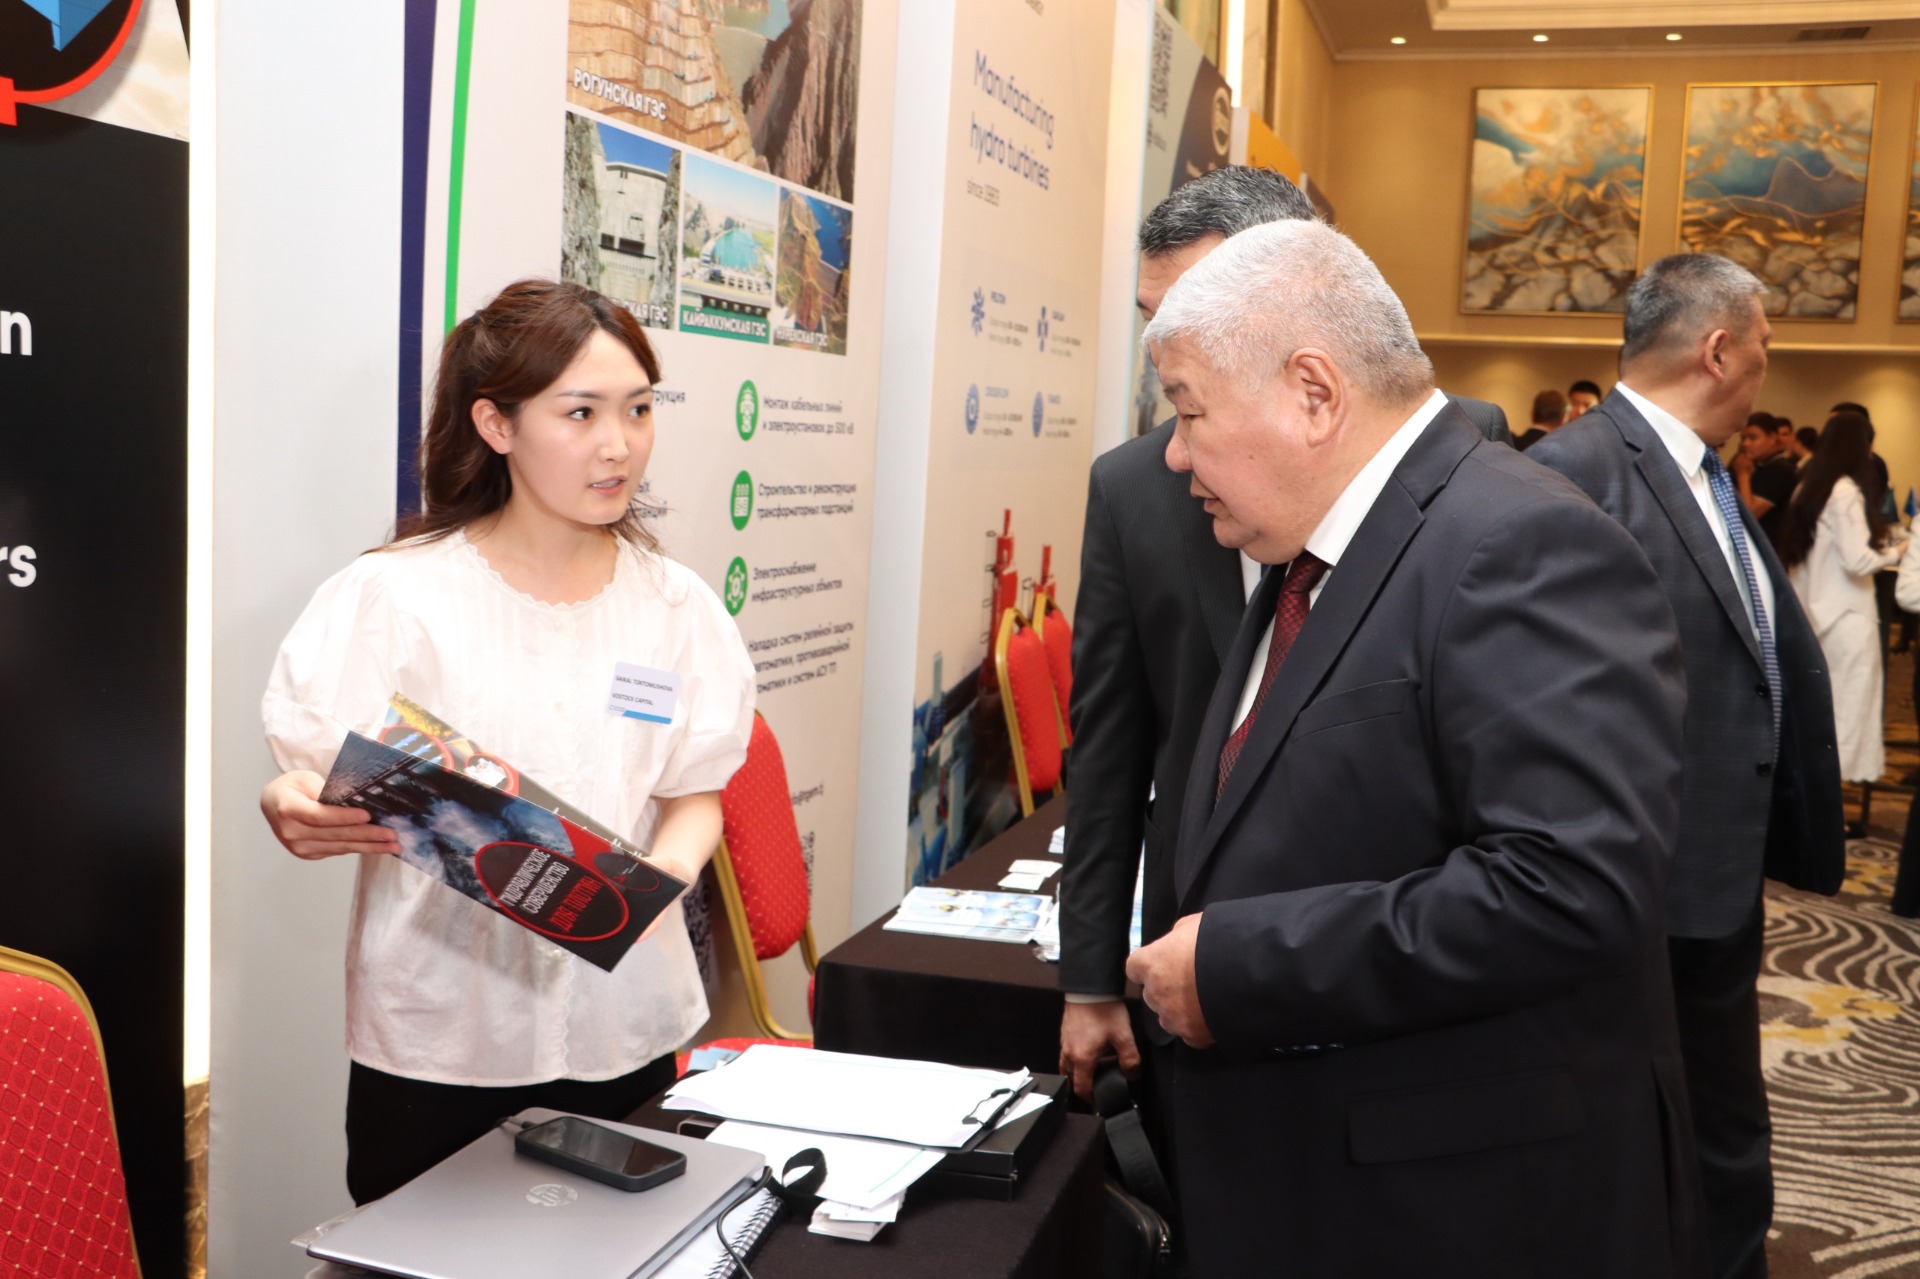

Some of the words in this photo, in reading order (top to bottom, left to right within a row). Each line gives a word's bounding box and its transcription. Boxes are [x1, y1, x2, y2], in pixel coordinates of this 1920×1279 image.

[573, 66, 643, 112] РОГУНСКАЯ
[644, 95, 668, 121] ГЭС
[974, 49, 1054, 149] Manufacturing
[970, 111, 1005, 164] hydro
[1008, 138, 1049, 190] turbines
[0, 310, 32, 356] n
[649, 304, 669, 323] ГЭС
[682, 308, 750, 333] КАЙРАККУМСКАЯ
[750, 319, 767, 337] ГЭС
[499, 847, 552, 907] ГИДРАВЛИЧЕСКОЕ
[521, 860, 570, 914] СОВЕРШЕНСТВО
[563, 875, 604, 916] ПЛОТИН
